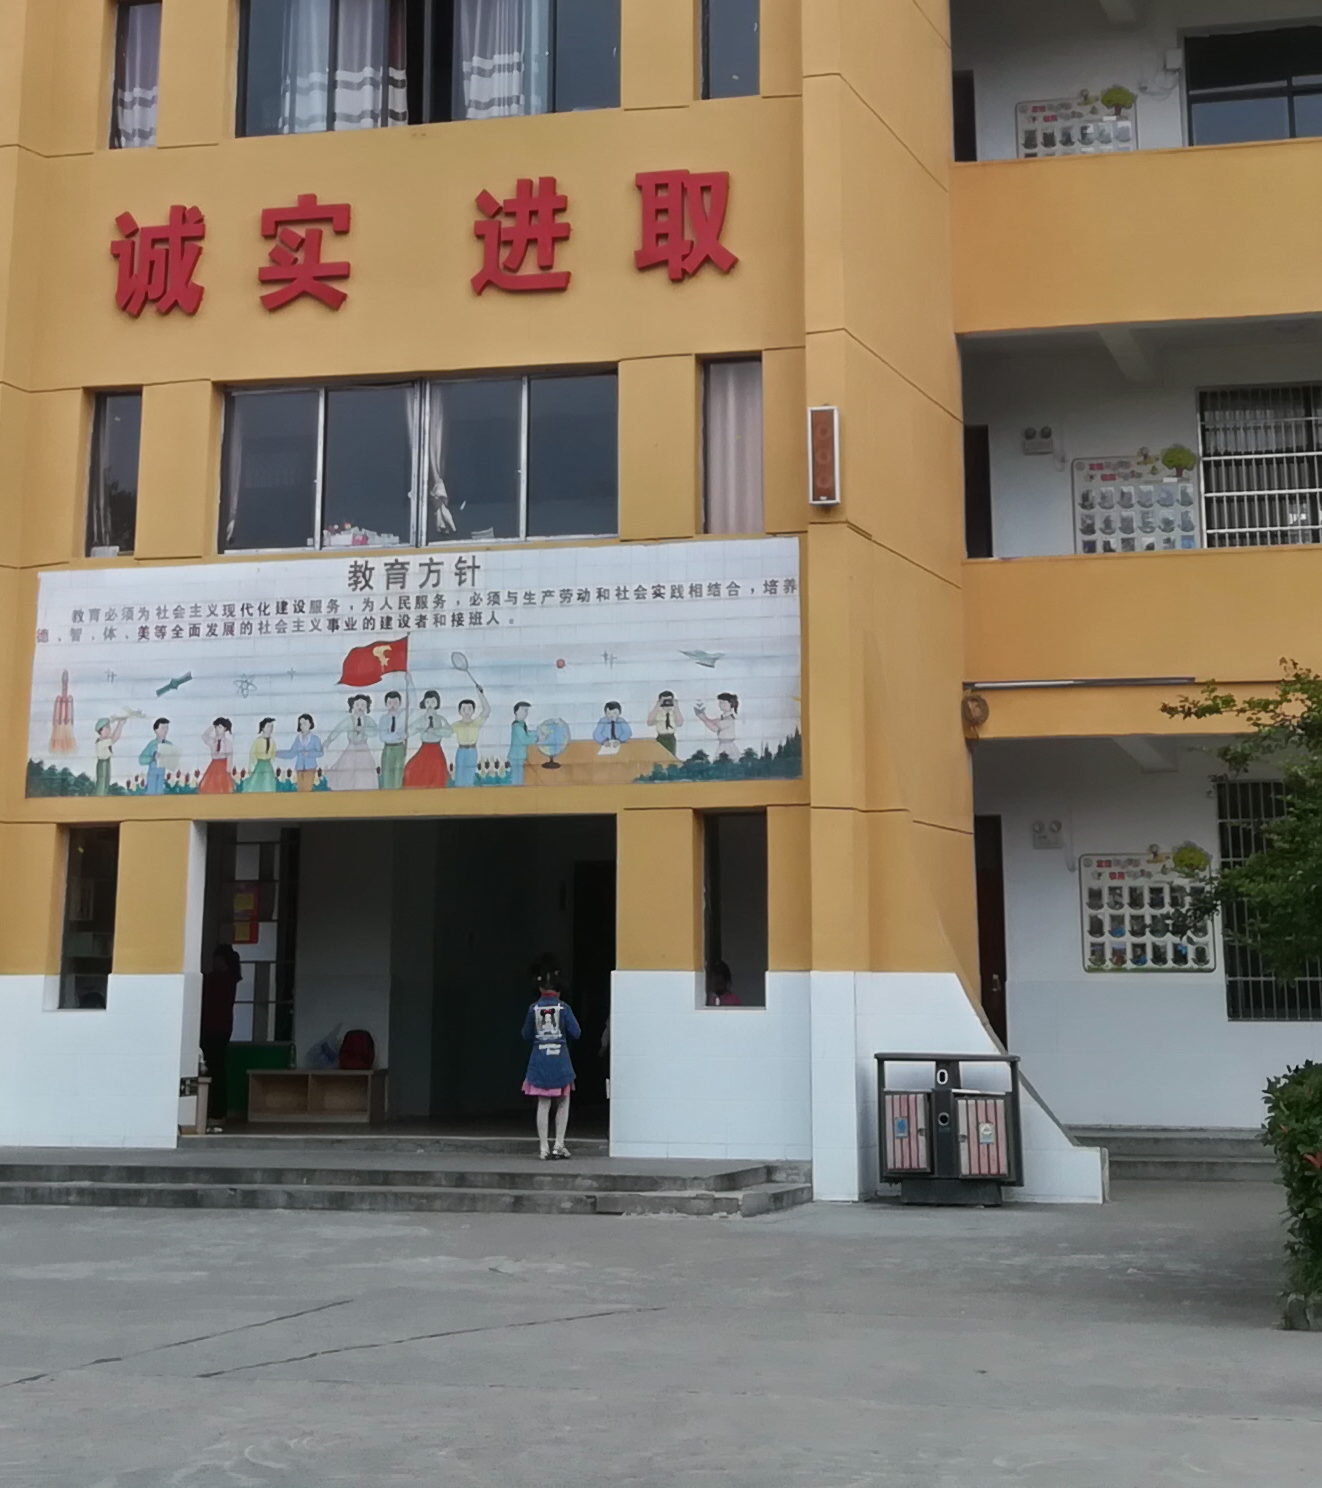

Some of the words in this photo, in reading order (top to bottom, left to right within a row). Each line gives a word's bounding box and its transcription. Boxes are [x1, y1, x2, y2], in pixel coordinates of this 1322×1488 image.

[111, 194, 352, 317] 诚实
[471, 168, 738, 297] 进取
[347, 555, 482, 593] 教育方针
